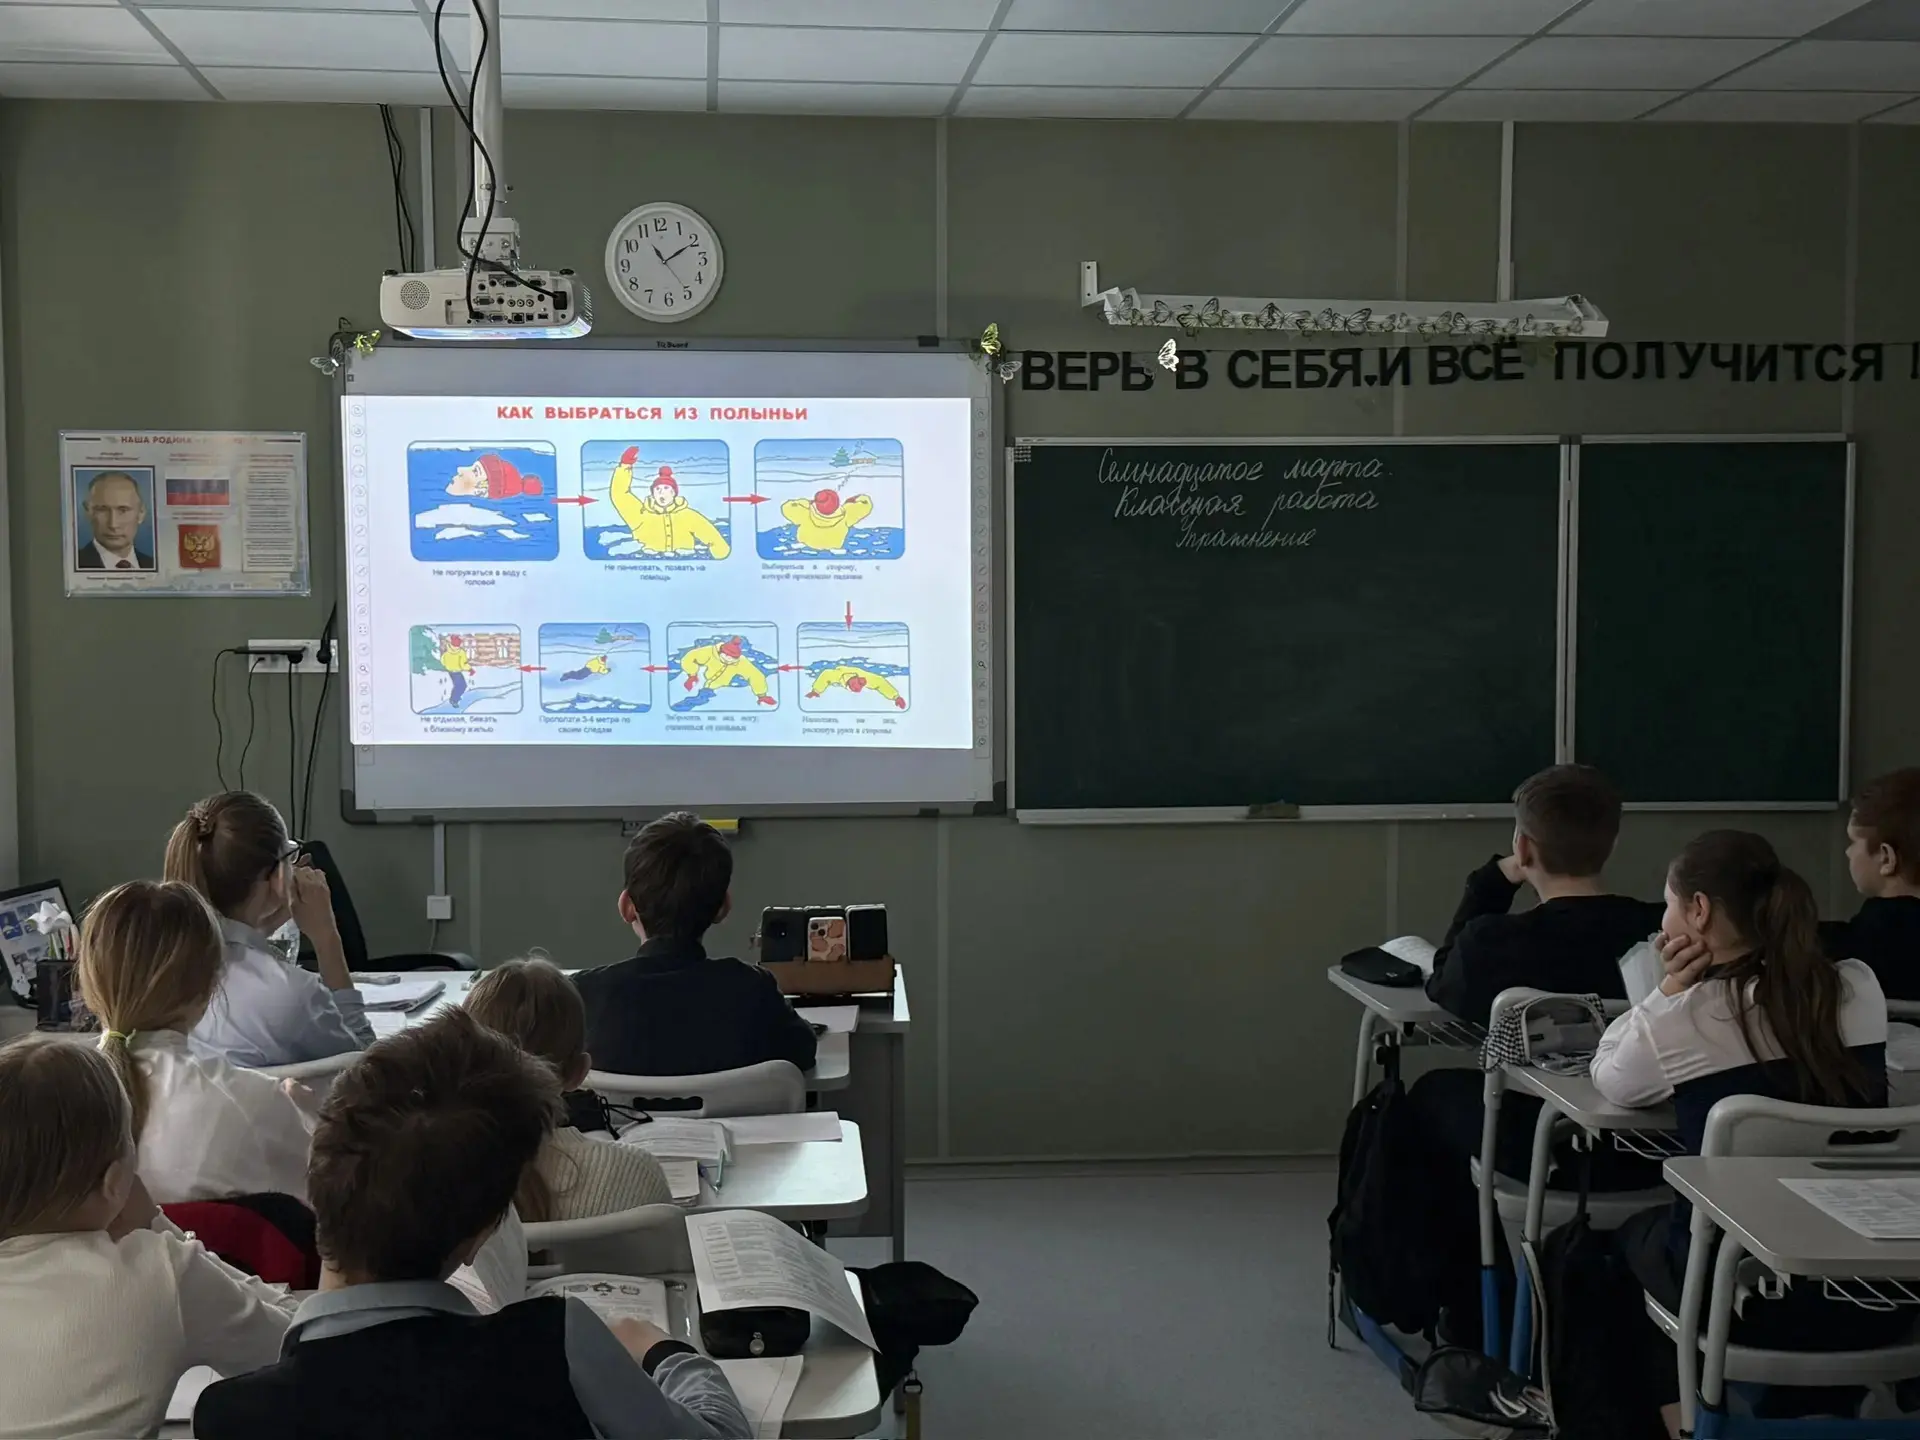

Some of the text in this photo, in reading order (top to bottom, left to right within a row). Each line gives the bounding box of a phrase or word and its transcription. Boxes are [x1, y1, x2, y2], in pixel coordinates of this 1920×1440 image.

[637, 223, 649, 239] 11
[653, 217, 668, 232] 12
[676, 221, 682, 236] 1
[624, 238, 639, 253] 10
[689, 233, 700, 247] 2
[620, 258, 631, 273] 9
[697, 251, 708, 266] 3
[629, 276, 639, 291] 8
[694, 271, 703, 285] 4
[644, 288, 654, 304] 7
[664, 291, 674, 307] 6
[683, 285, 693, 300] 5
[1021, 350, 1156, 391] ВЕРЬ
[1175, 349, 1209, 390] В
[1227, 347, 1363, 389] СЕБЯ
[1378, 346, 1411, 386] И
[1428, 335, 1524, 386] ВСЁ
[1554, 341, 1884, 382] ПОЛУЧИТСЯ
[497, 406, 808, 421] КАК ВЫБРАТЬСЯ ИЗ ПОЛЫНЬИ
[121, 436, 150, 445] НАША
[152, 436, 192, 445] РОДИНА
[1098, 447, 1265, 493] Семнадцатое
[1114, 484, 1381, 531] Классная работа
[432, 569, 443, 577] Не
[446, 569, 493, 578] погружаться
[502, 570, 520, 579] воду
[604, 563, 615, 571] Не
[464, 577, 496, 586] головой
